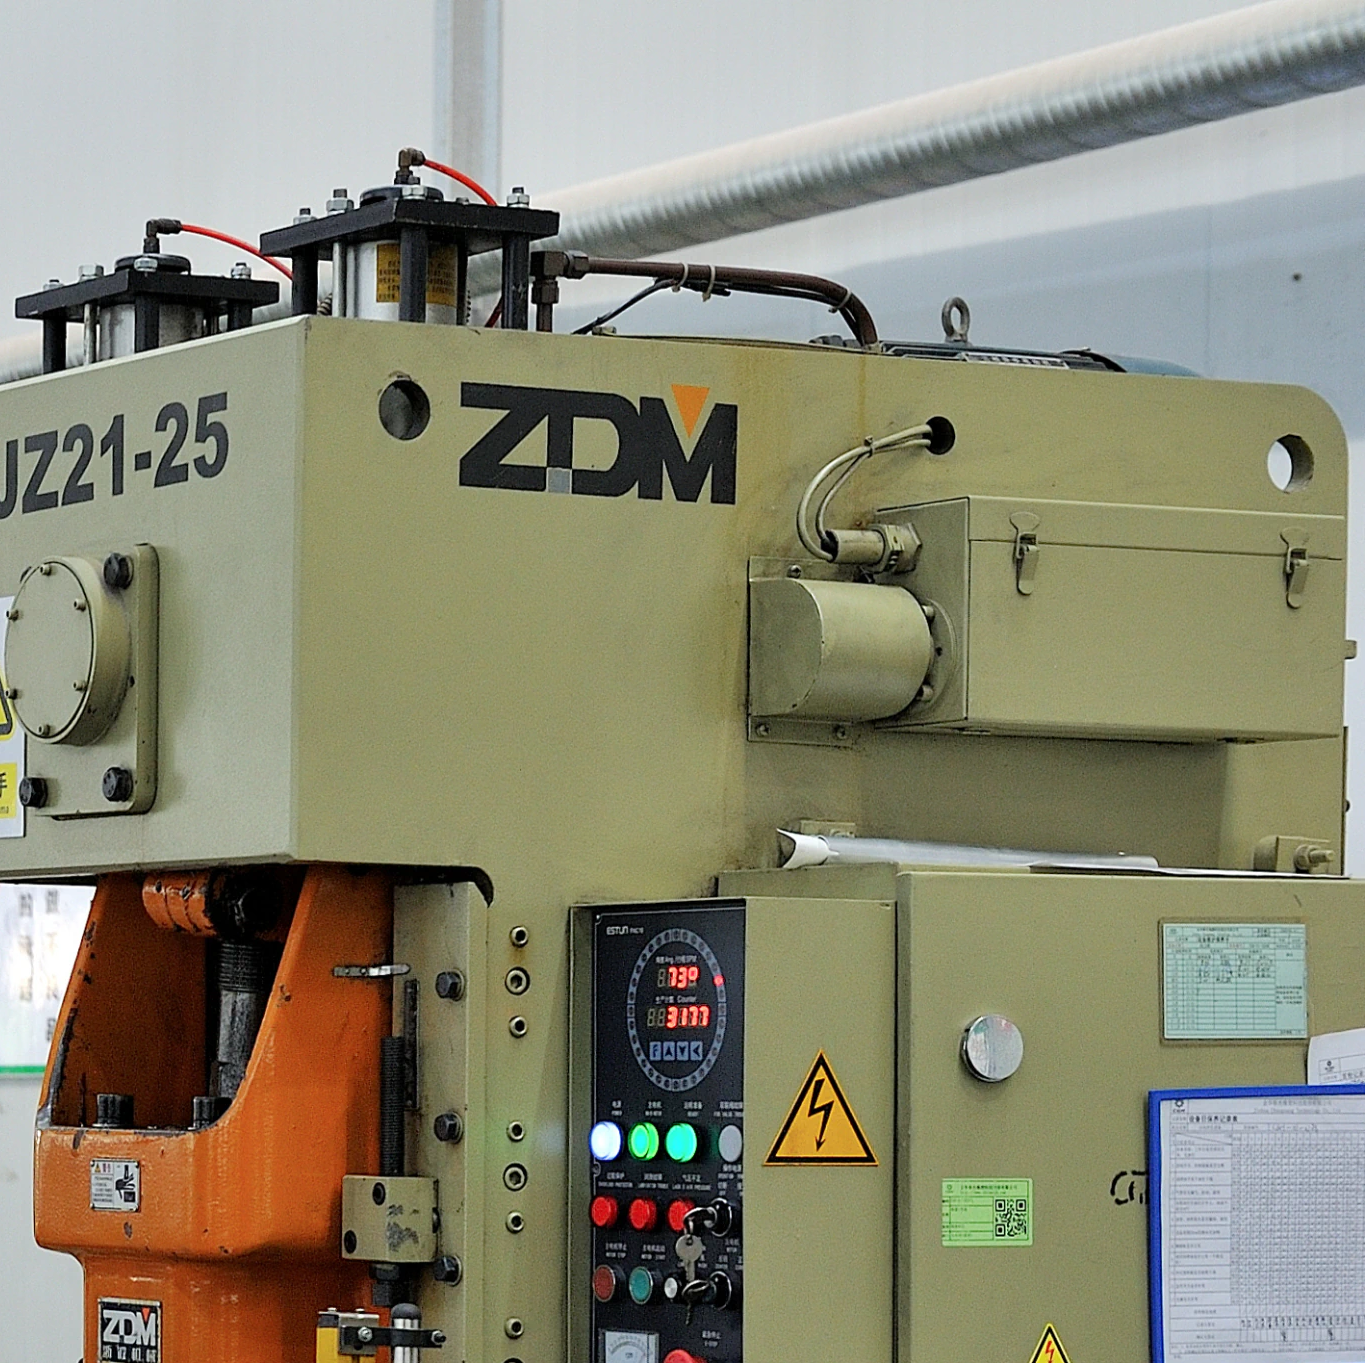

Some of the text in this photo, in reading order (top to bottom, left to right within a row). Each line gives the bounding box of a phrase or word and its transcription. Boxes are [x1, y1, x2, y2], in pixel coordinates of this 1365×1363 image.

[459, 381, 738, 505] ZDM
[666, 1006, 710, 1028] 3177
[103, 1309, 156, 1346] ZDM
